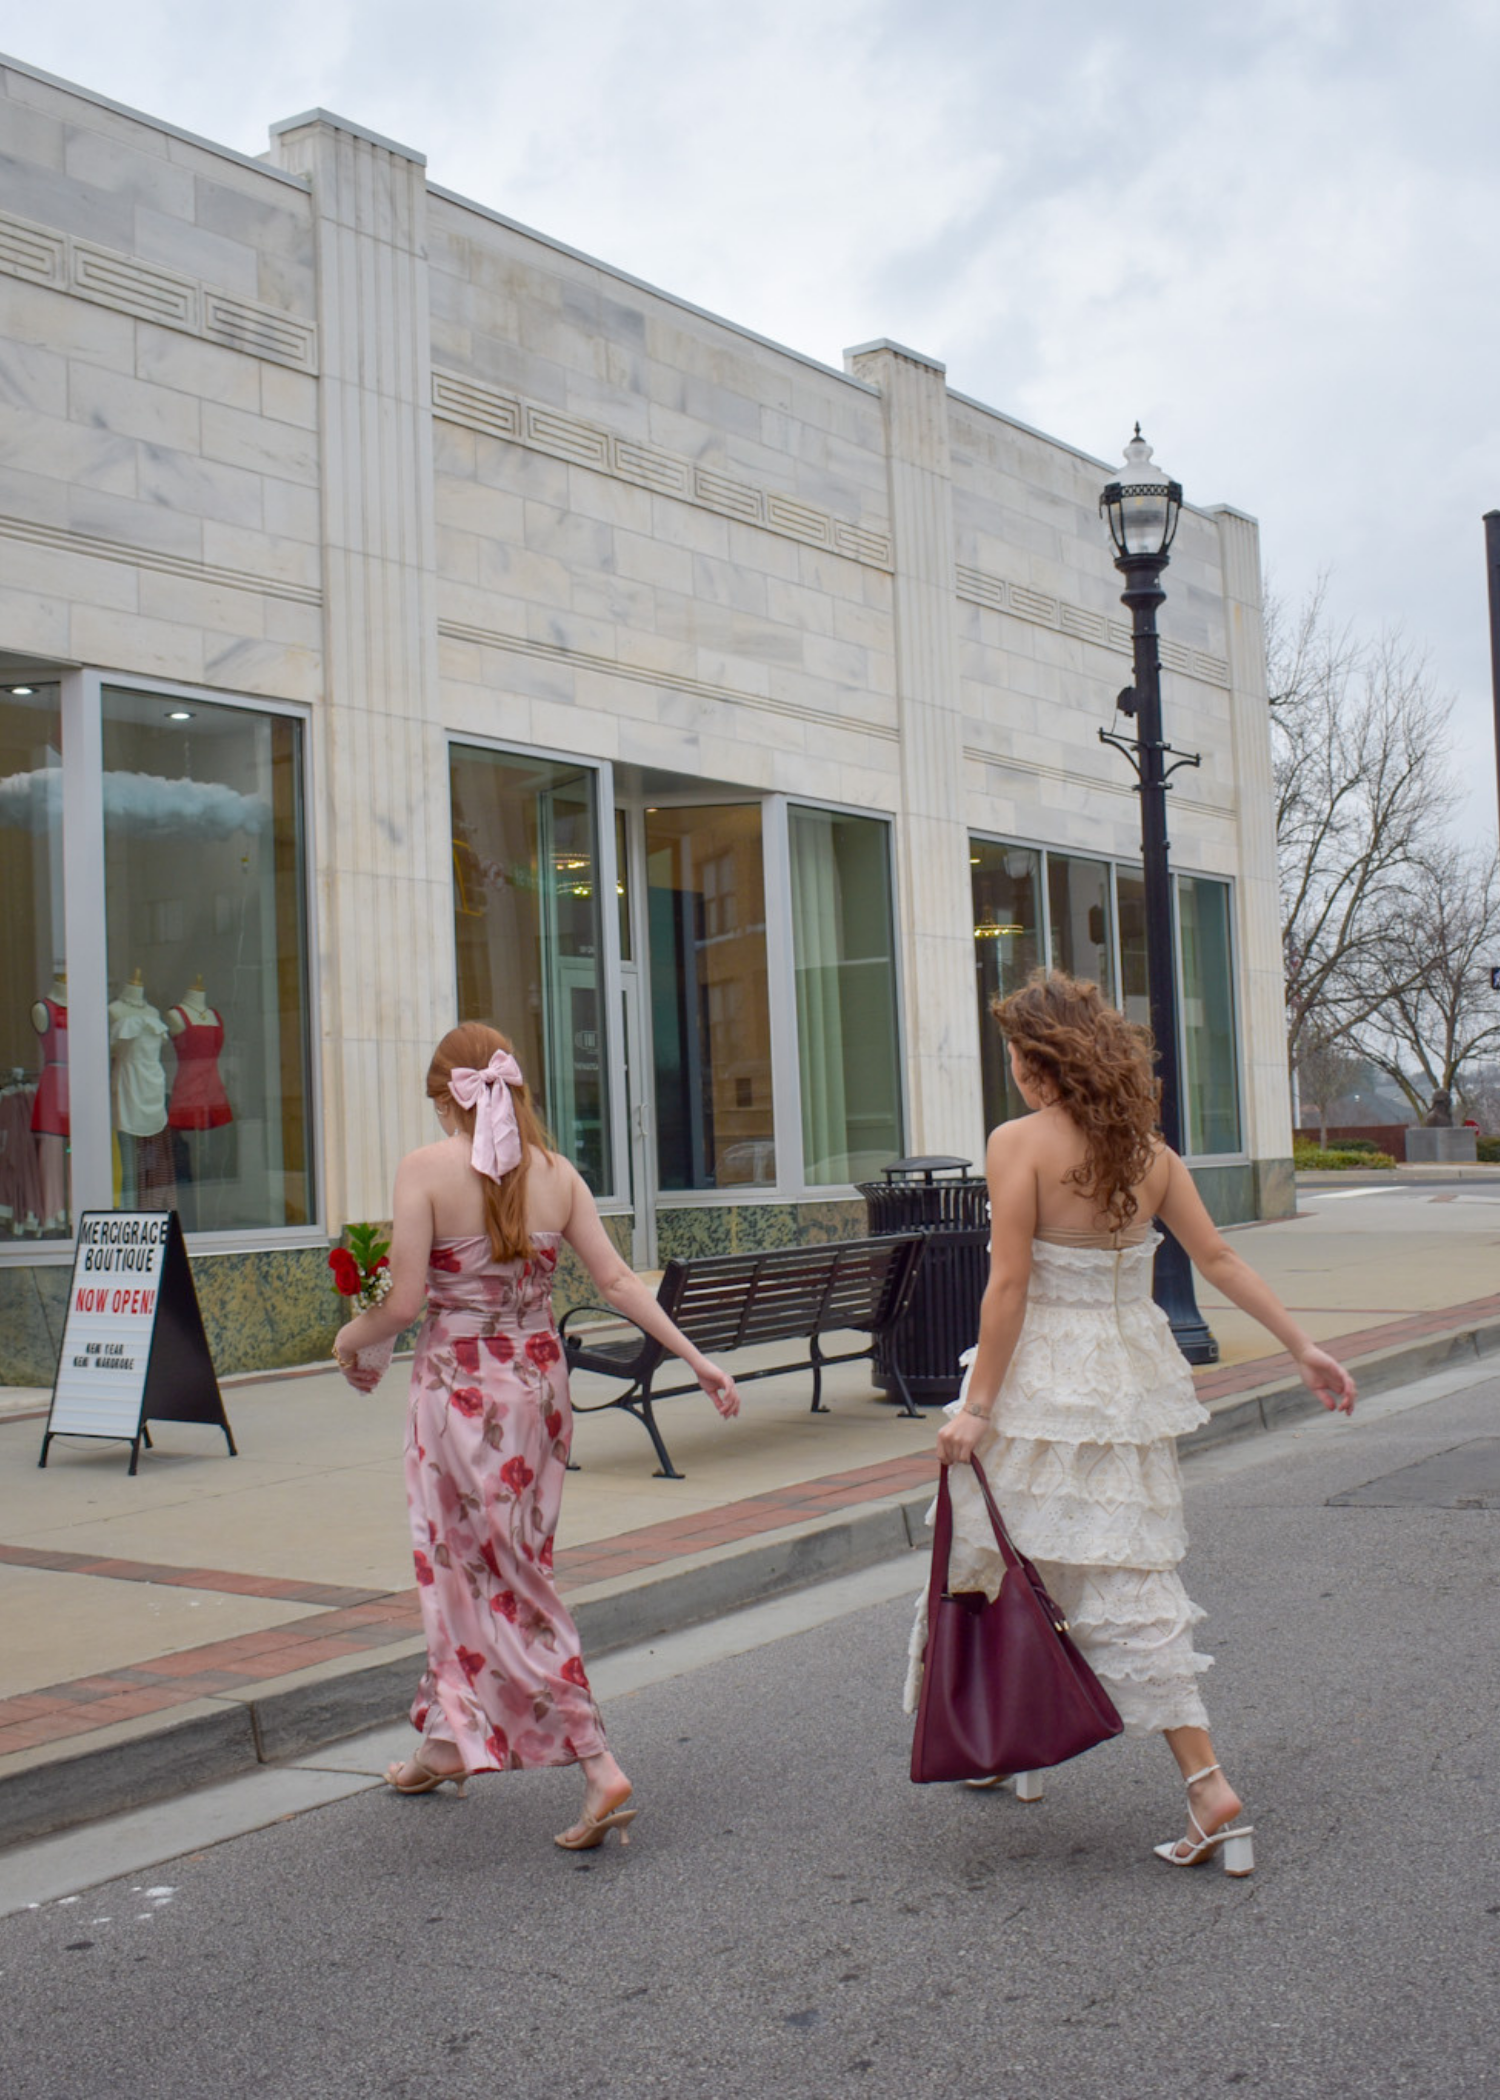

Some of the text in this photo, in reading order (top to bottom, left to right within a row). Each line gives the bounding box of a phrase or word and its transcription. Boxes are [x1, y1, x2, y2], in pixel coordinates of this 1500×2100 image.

[80, 1221, 169, 1245] MERCIGRACE
[85, 1248, 155, 1272] BOUTIQUE
[76, 1287, 155, 1315] NOW OPEN!
[86, 1342, 124, 1355] NEW YEAR
[73, 1356, 135, 1370] NEW WARDROBE
